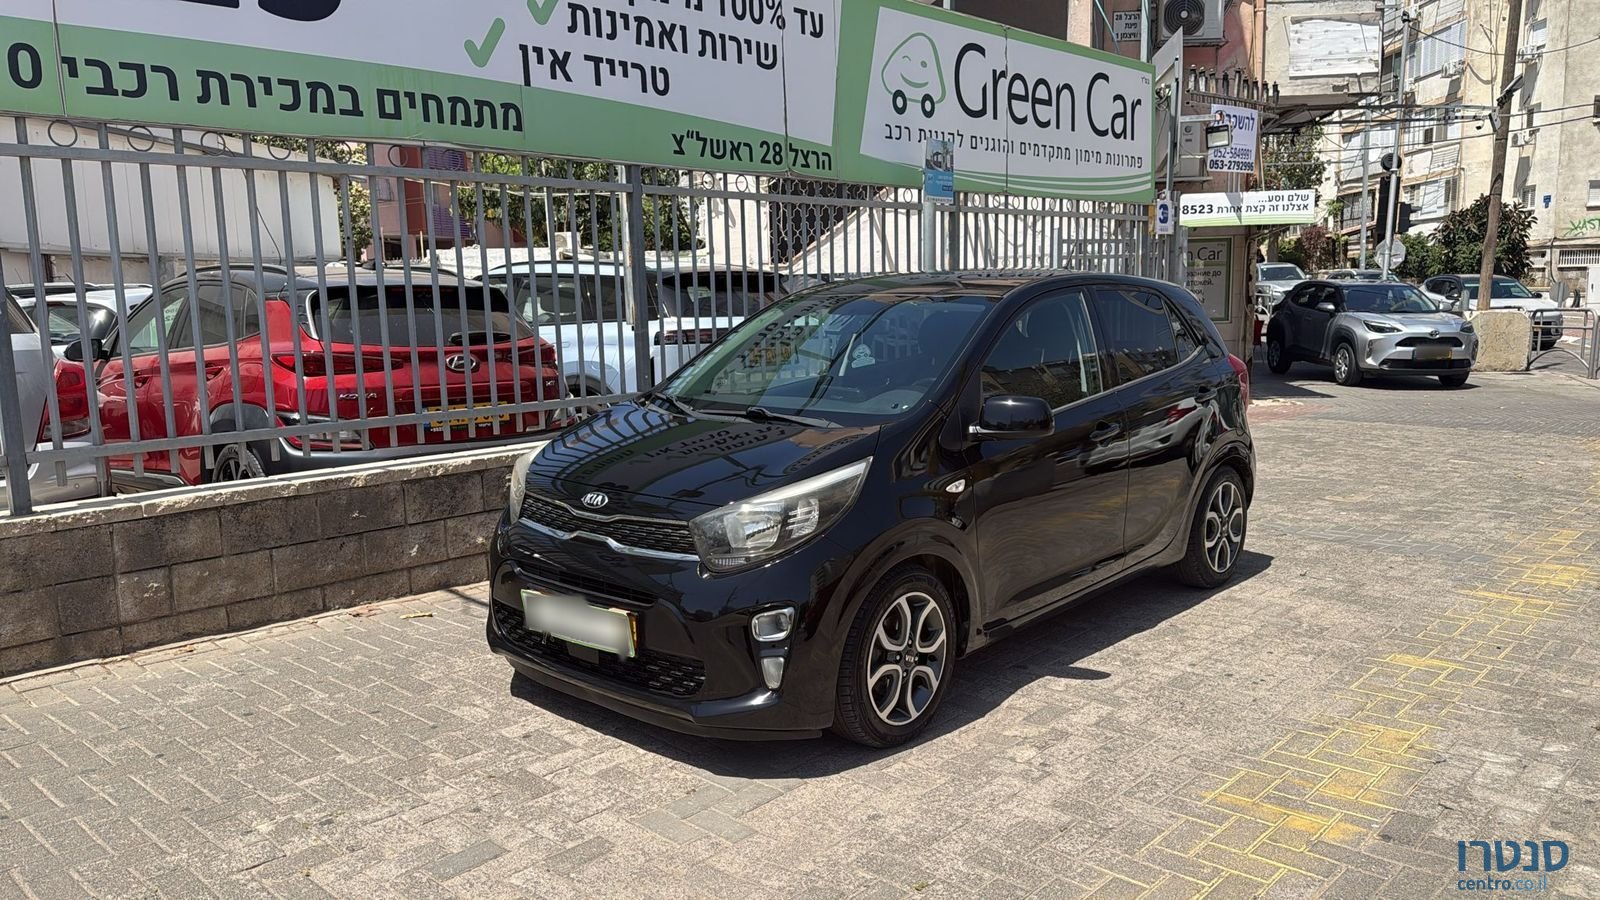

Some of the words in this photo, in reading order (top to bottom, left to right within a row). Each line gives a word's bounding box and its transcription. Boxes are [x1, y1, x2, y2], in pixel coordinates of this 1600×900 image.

[567, 3, 688, 54] ואמינות
[793, 6, 824, 39] עד
[698, 28, 778, 71] שירות
[7, 42, 43, 89] 0
[518, 43, 573, 87] אין
[583, 54, 671, 97] טרייד
[61, 56, 181, 101] רכבי
[195, 69, 364, 118] במכירת
[953, 42, 1076, 132] Green
[1086, 72, 1142, 141] Car
[376, 87, 524, 132] מתמחים
[885, 123, 912, 142] רכב
[759, 140, 784, 165] 28
[969, 134, 1014, 155] והוגנים
[1019, 141, 1071, 163] מתקדמים
[788, 143, 832, 171] הרצל
[1075, 148, 1102, 165] מימון
[1105, 152, 1143, 169] פתרונות
[1269, 203, 1279, 212] זה
[1282, 202, 1309, 212] אצלנו
[1287, 193, 1309, 202] שלם
[1216, 205, 1242, 214] אחרת
[1246, 204, 1266, 215] קצת
[1197, 246, 1223, 261] Car
[584, 493, 603, 505] KIA
